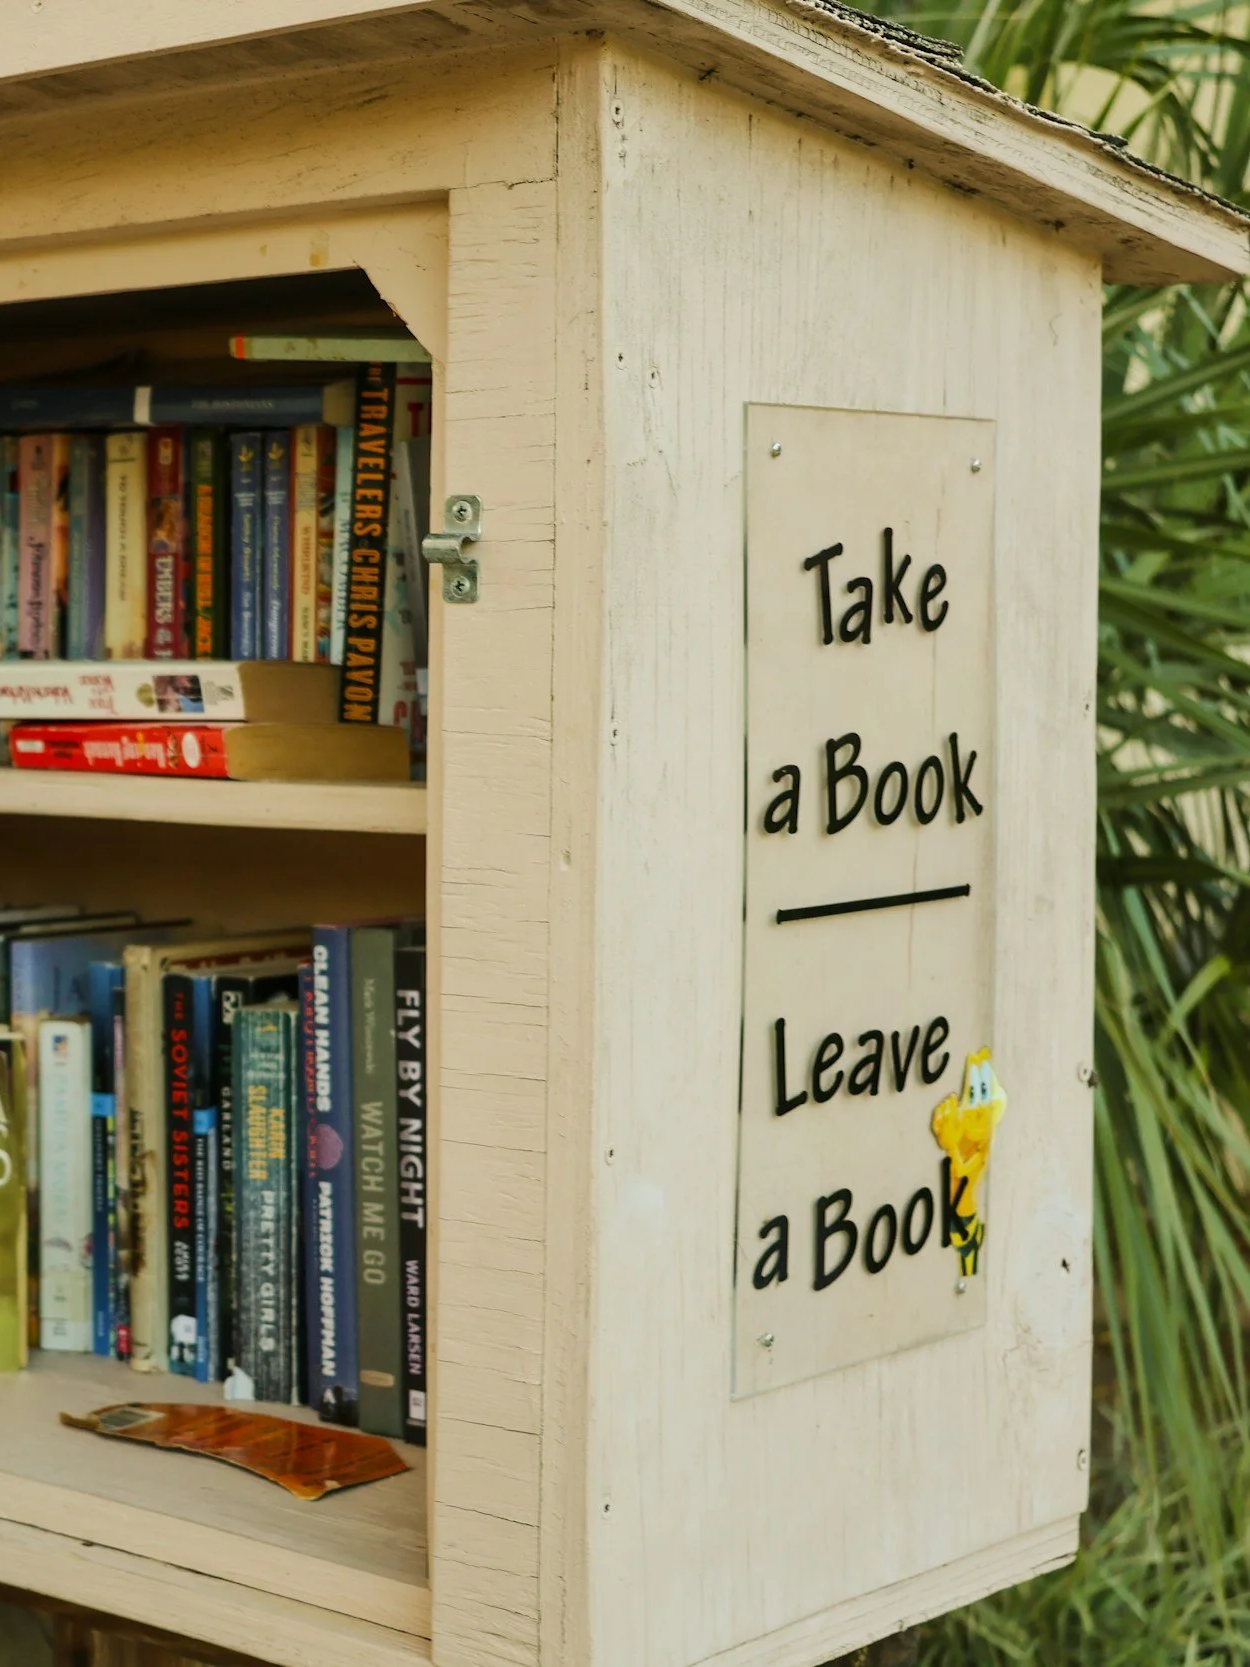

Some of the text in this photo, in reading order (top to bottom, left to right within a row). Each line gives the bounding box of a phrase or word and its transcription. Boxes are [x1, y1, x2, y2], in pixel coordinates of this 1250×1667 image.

[354, 388, 389, 536] TRAVELERS
[348, 549, 381, 629] CHRIS
[803, 527, 949, 645] Take
[763, 732, 983, 835] a Book
[397, 989, 421, 1049] FLY
[398, 1060, 422, 1108] BY
[775, 1016, 950, 1117] Leave
[171, 992, 190, 1229] THE SOVIET SISTERS
[221, 1086, 232, 1171] GARLAND
[248, 1085, 269, 1181] SLAUGHTER
[269, 1107, 286, 1160] KARIN
[360, 1101, 386, 1193] WATCH
[313, 945, 336, 1377] CLEAN HANDS PATRICK HOFFMAN
[399, 1117, 425, 1229] NIGHT
[261, 1190, 276, 1276] PRETTY
[362, 1202, 386, 1241] ME
[752, 1156, 969, 1291] a Book
[363, 1250, 386, 1285] GO
[405, 1260, 421, 1308] WARD
[260, 1282, 277, 1351] GIRLS
[406, 1313, 422, 1376] LARSEN
